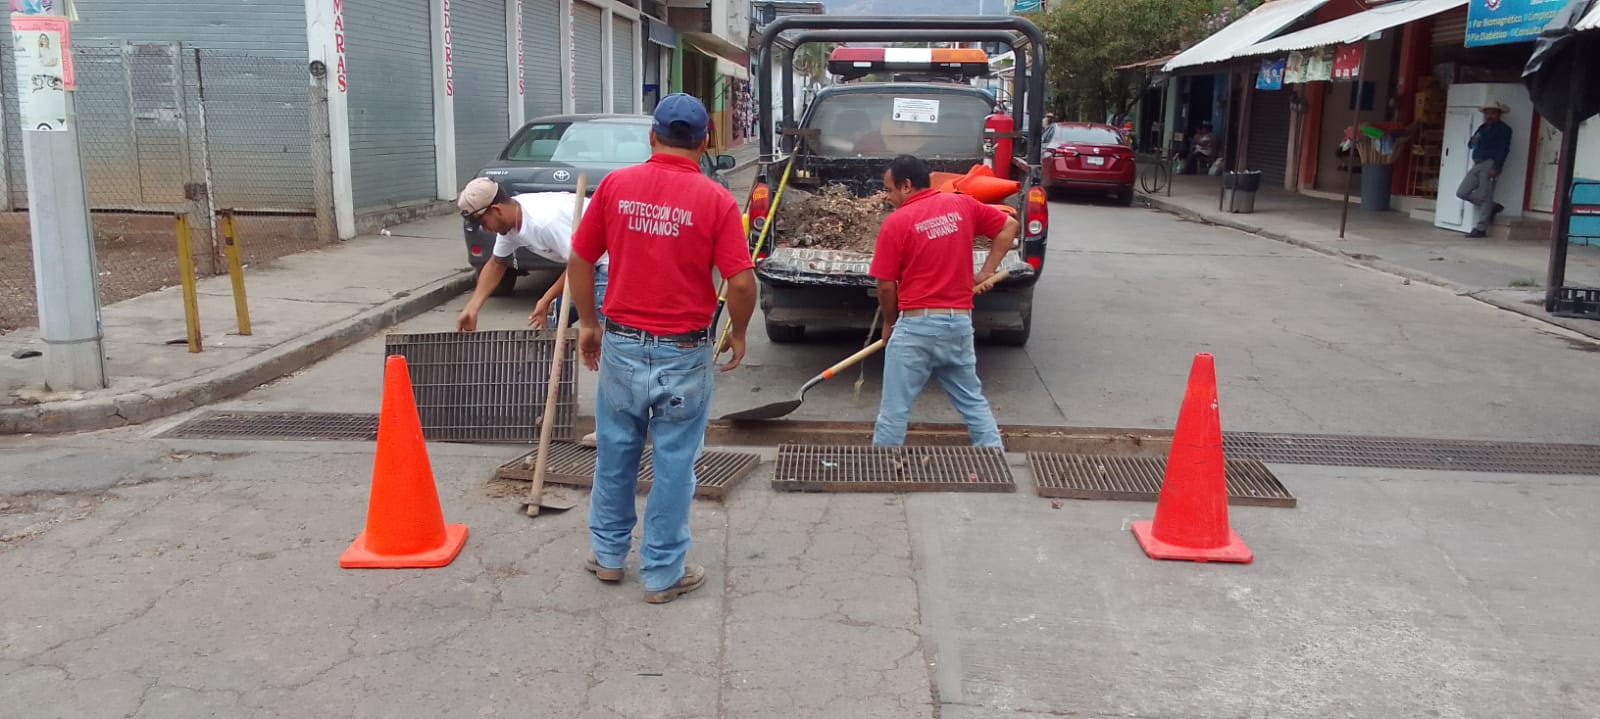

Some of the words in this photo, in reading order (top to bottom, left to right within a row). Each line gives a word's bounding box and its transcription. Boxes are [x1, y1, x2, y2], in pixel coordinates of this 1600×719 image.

[618, 200, 671, 220] PROTECCIÓN
[672, 207, 693, 226] CIVIL
[947, 211, 962, 223] CIVIL
[628, 216, 679, 237] LUVIANOS
[926, 222, 958, 239] LUVIANOS
